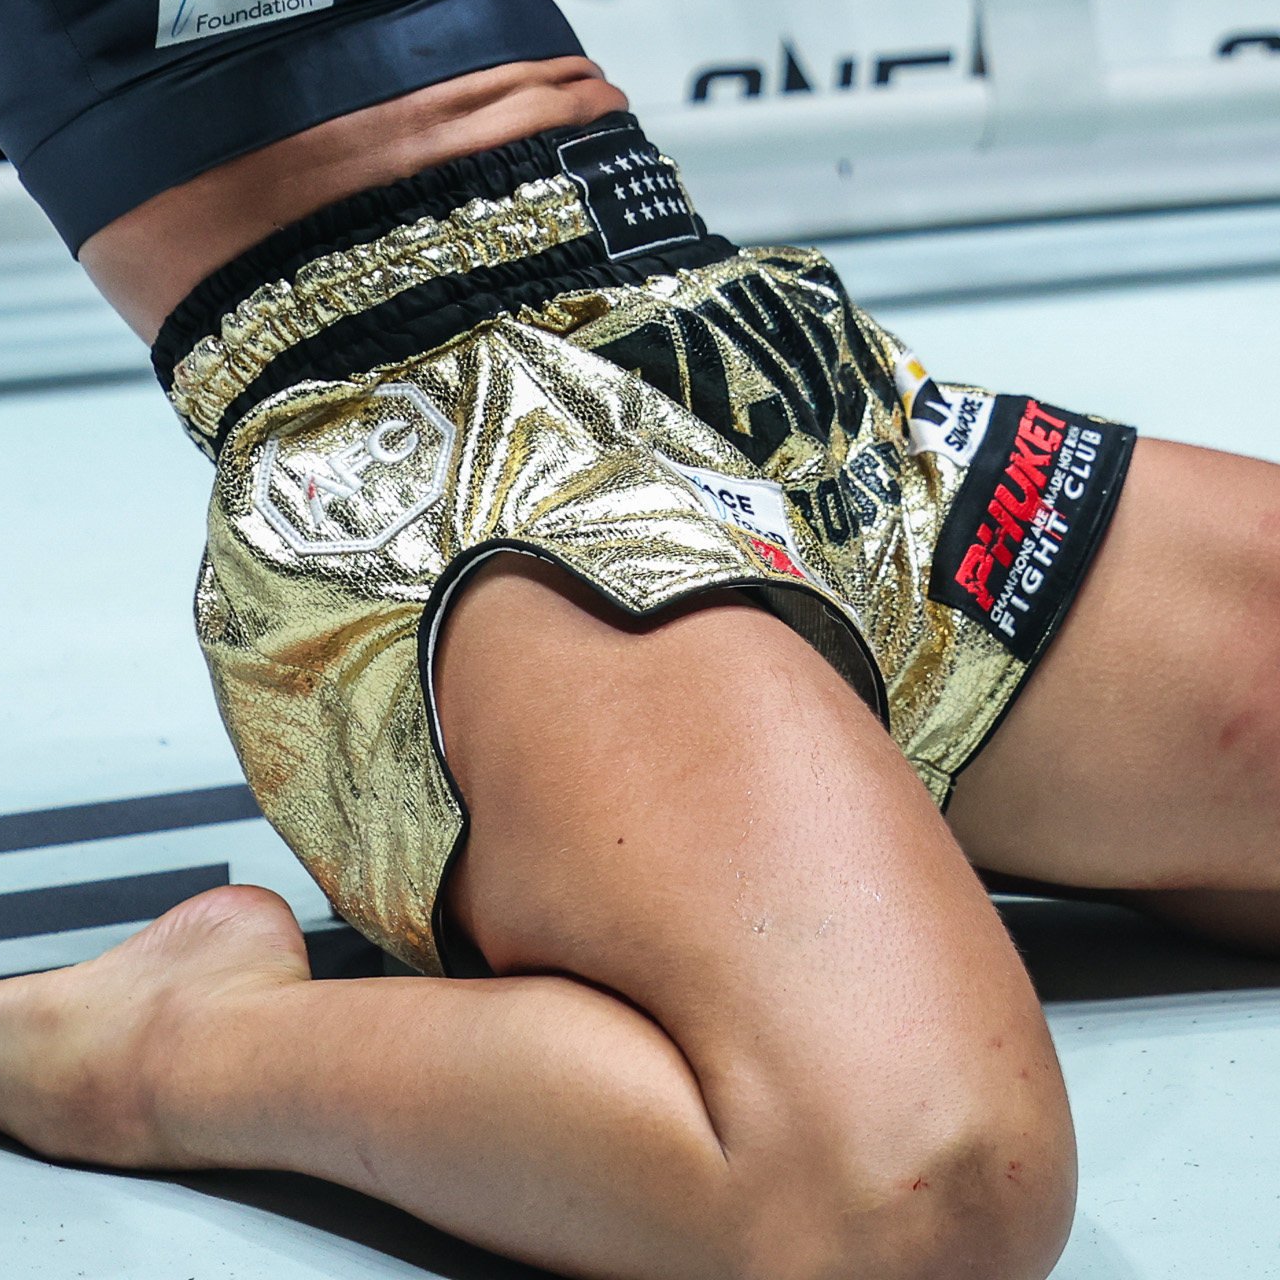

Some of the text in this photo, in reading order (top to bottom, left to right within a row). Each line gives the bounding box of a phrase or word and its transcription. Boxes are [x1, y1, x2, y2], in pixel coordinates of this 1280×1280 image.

[954, 400, 1066, 612] PHUKET
[990, 537, 1036, 623] CHAMPIONS
[1030, 508, 1050, 540] ARE
[1043, 472, 1067, 510] MADE
[1057, 449, 1075, 473] NOT
[998, 429, 1102, 638] FIGHT CLUB
